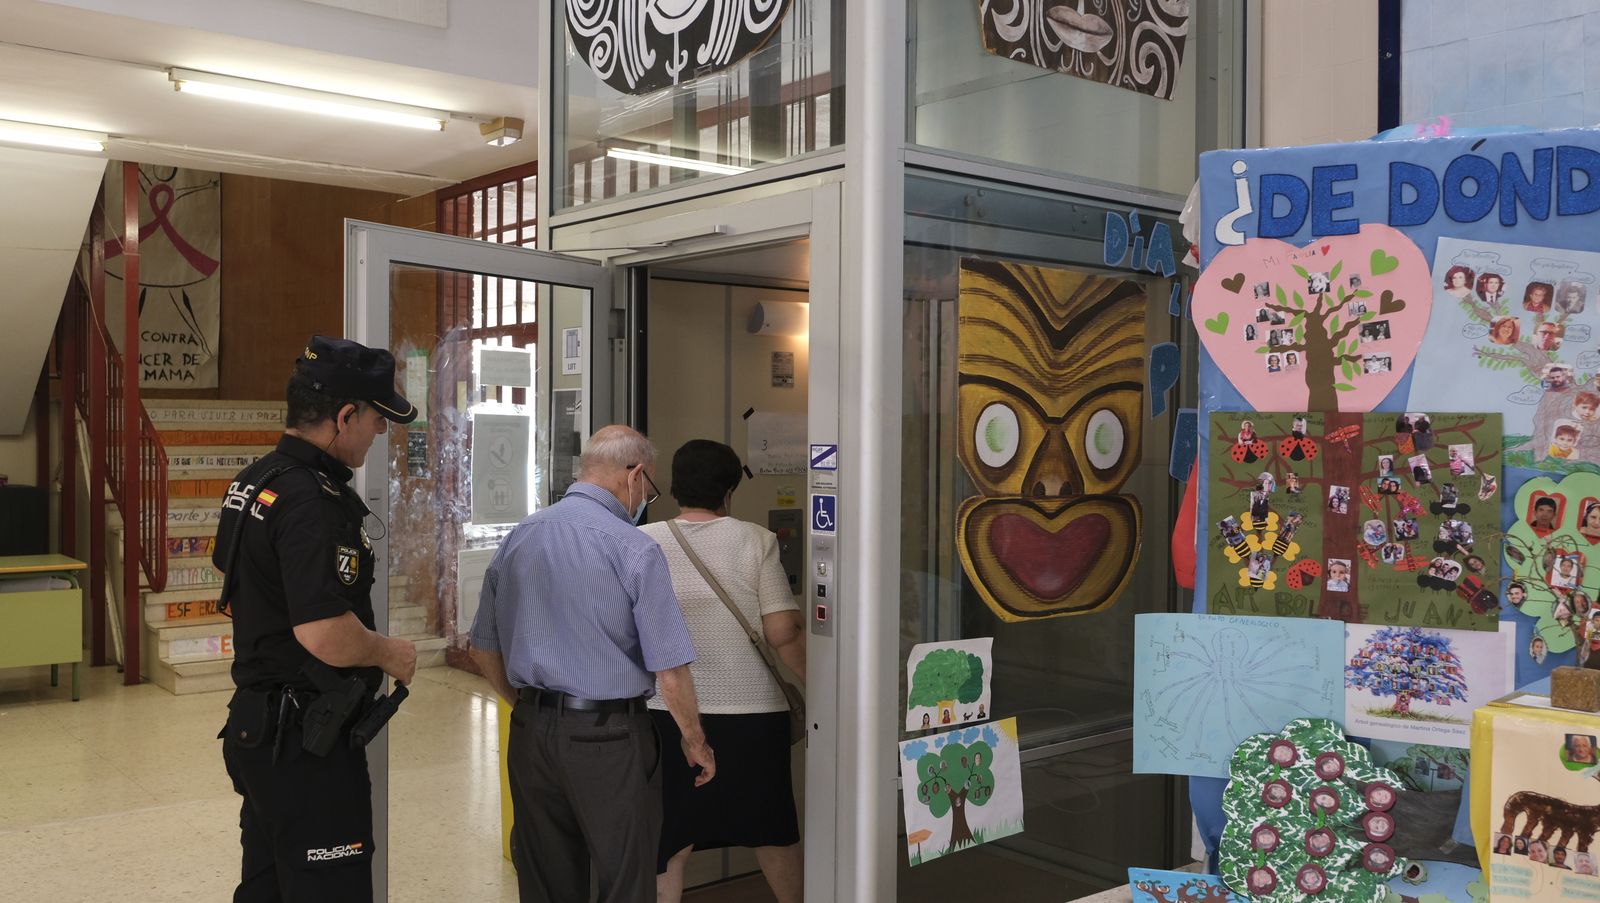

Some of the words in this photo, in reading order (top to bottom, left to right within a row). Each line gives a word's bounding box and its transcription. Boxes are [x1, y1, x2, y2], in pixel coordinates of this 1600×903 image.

[1214, 159, 1360, 246] ¿DE
[1388, 138, 1600, 227] DÓND
[141, 330, 199, 346] CONTRA
[138, 352, 174, 366] CER
[182, 352, 201, 366] DE
[144, 368, 195, 381] MAMA
[164, 410, 195, 420] PARA
[256, 411, 279, 421] PAZ
[1410, 724, 1431, 732] Martina
[307, 844, 352, 856] POLICIA
[307, 849, 363, 861] NACIONAL
